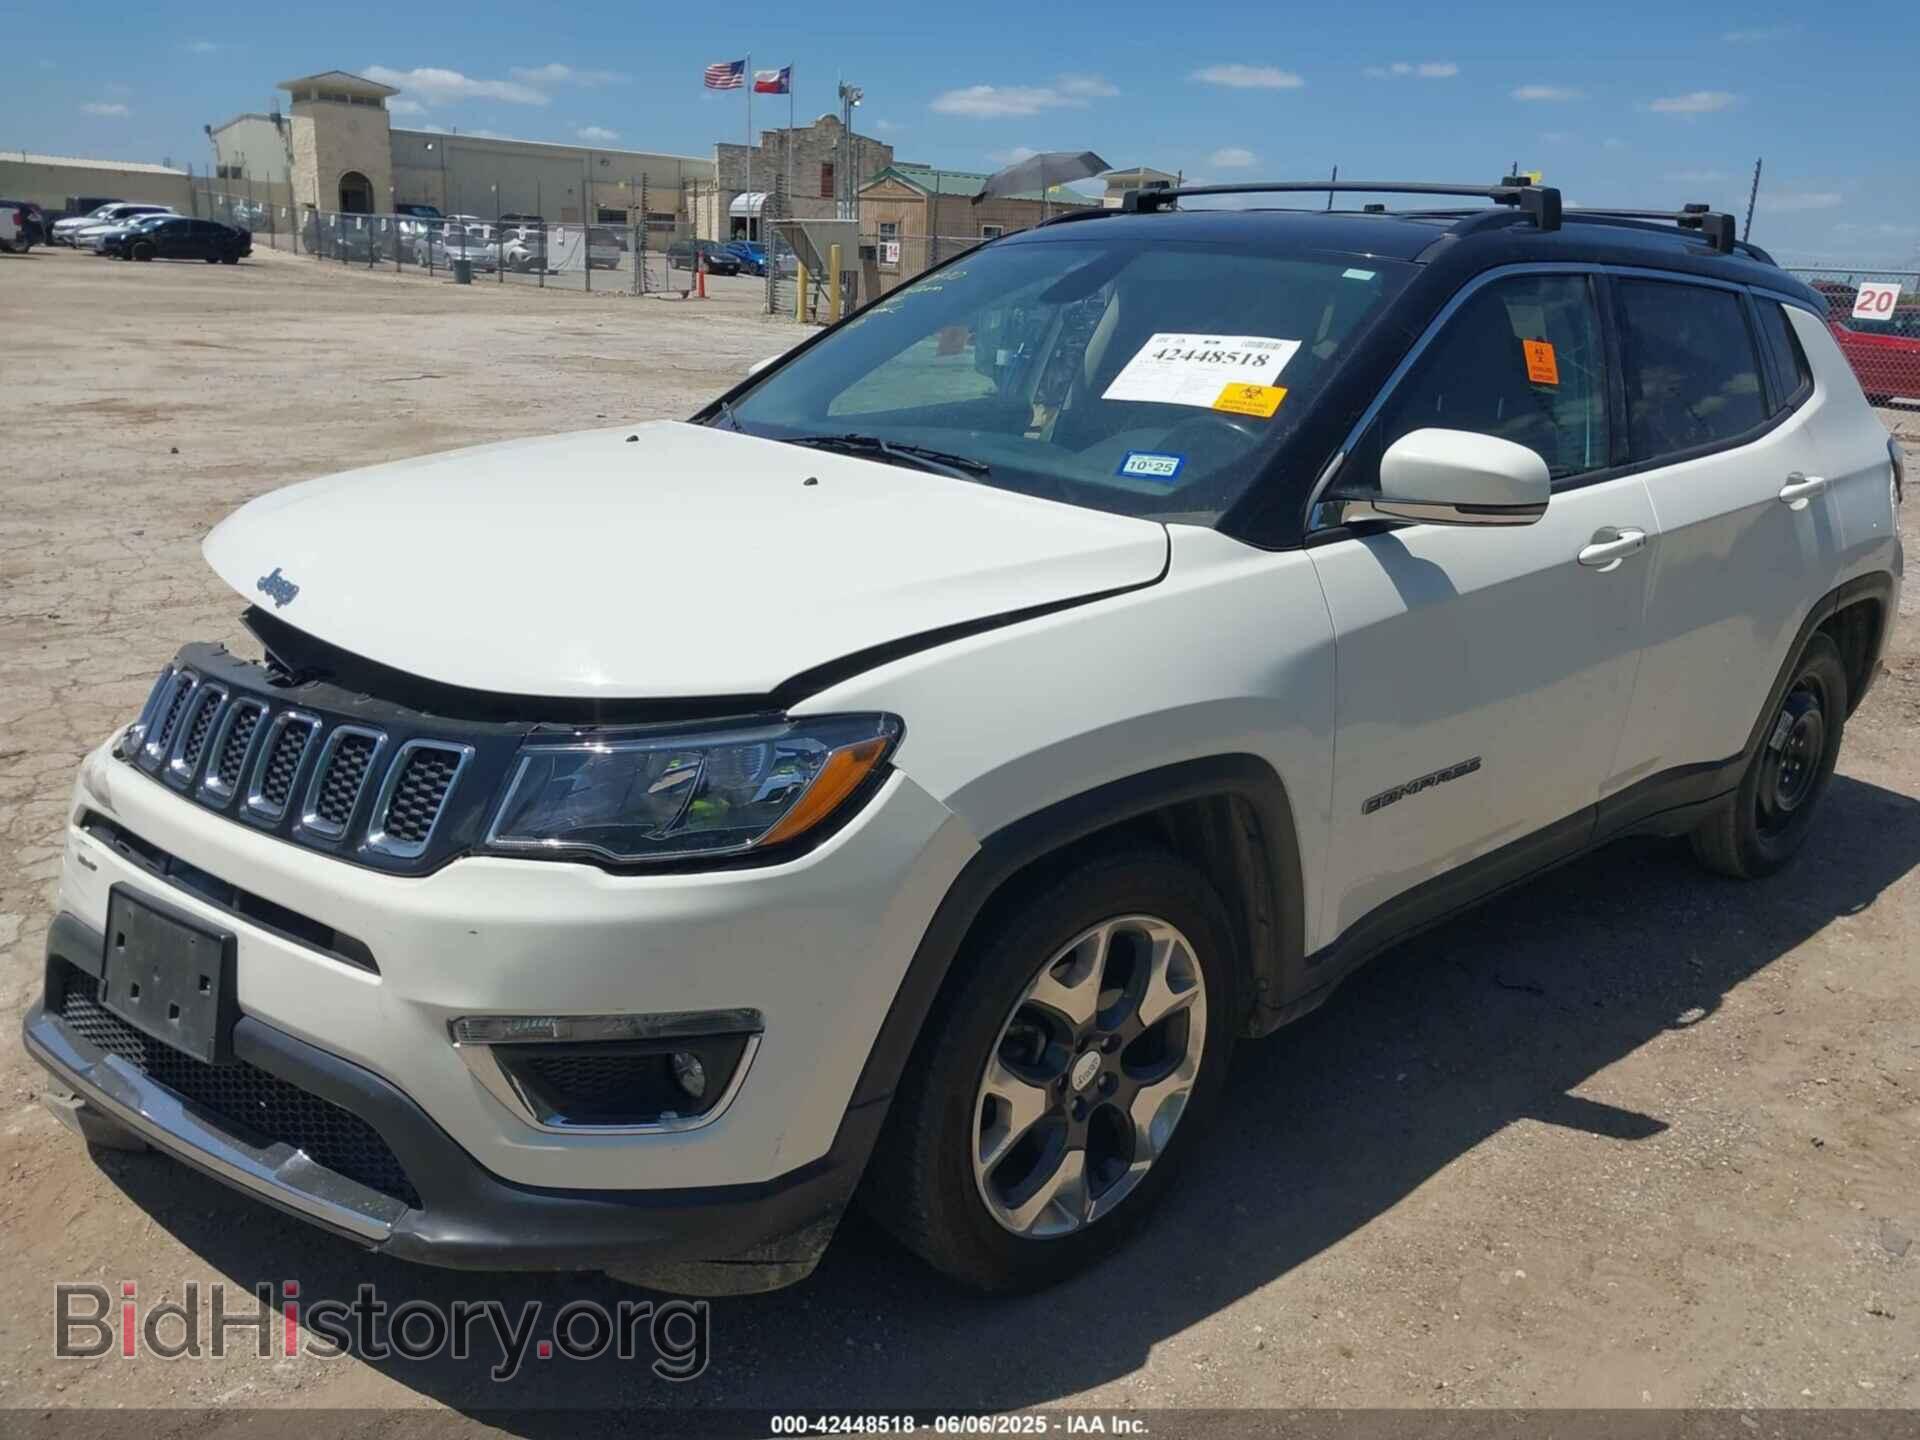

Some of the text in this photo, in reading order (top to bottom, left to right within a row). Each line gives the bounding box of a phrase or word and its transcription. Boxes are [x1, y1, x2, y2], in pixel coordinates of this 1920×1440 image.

[1856, 289, 1893, 313] 20
[1152, 348, 1271, 368] 42448518
[1129, 460, 1173, 473] 10 25
